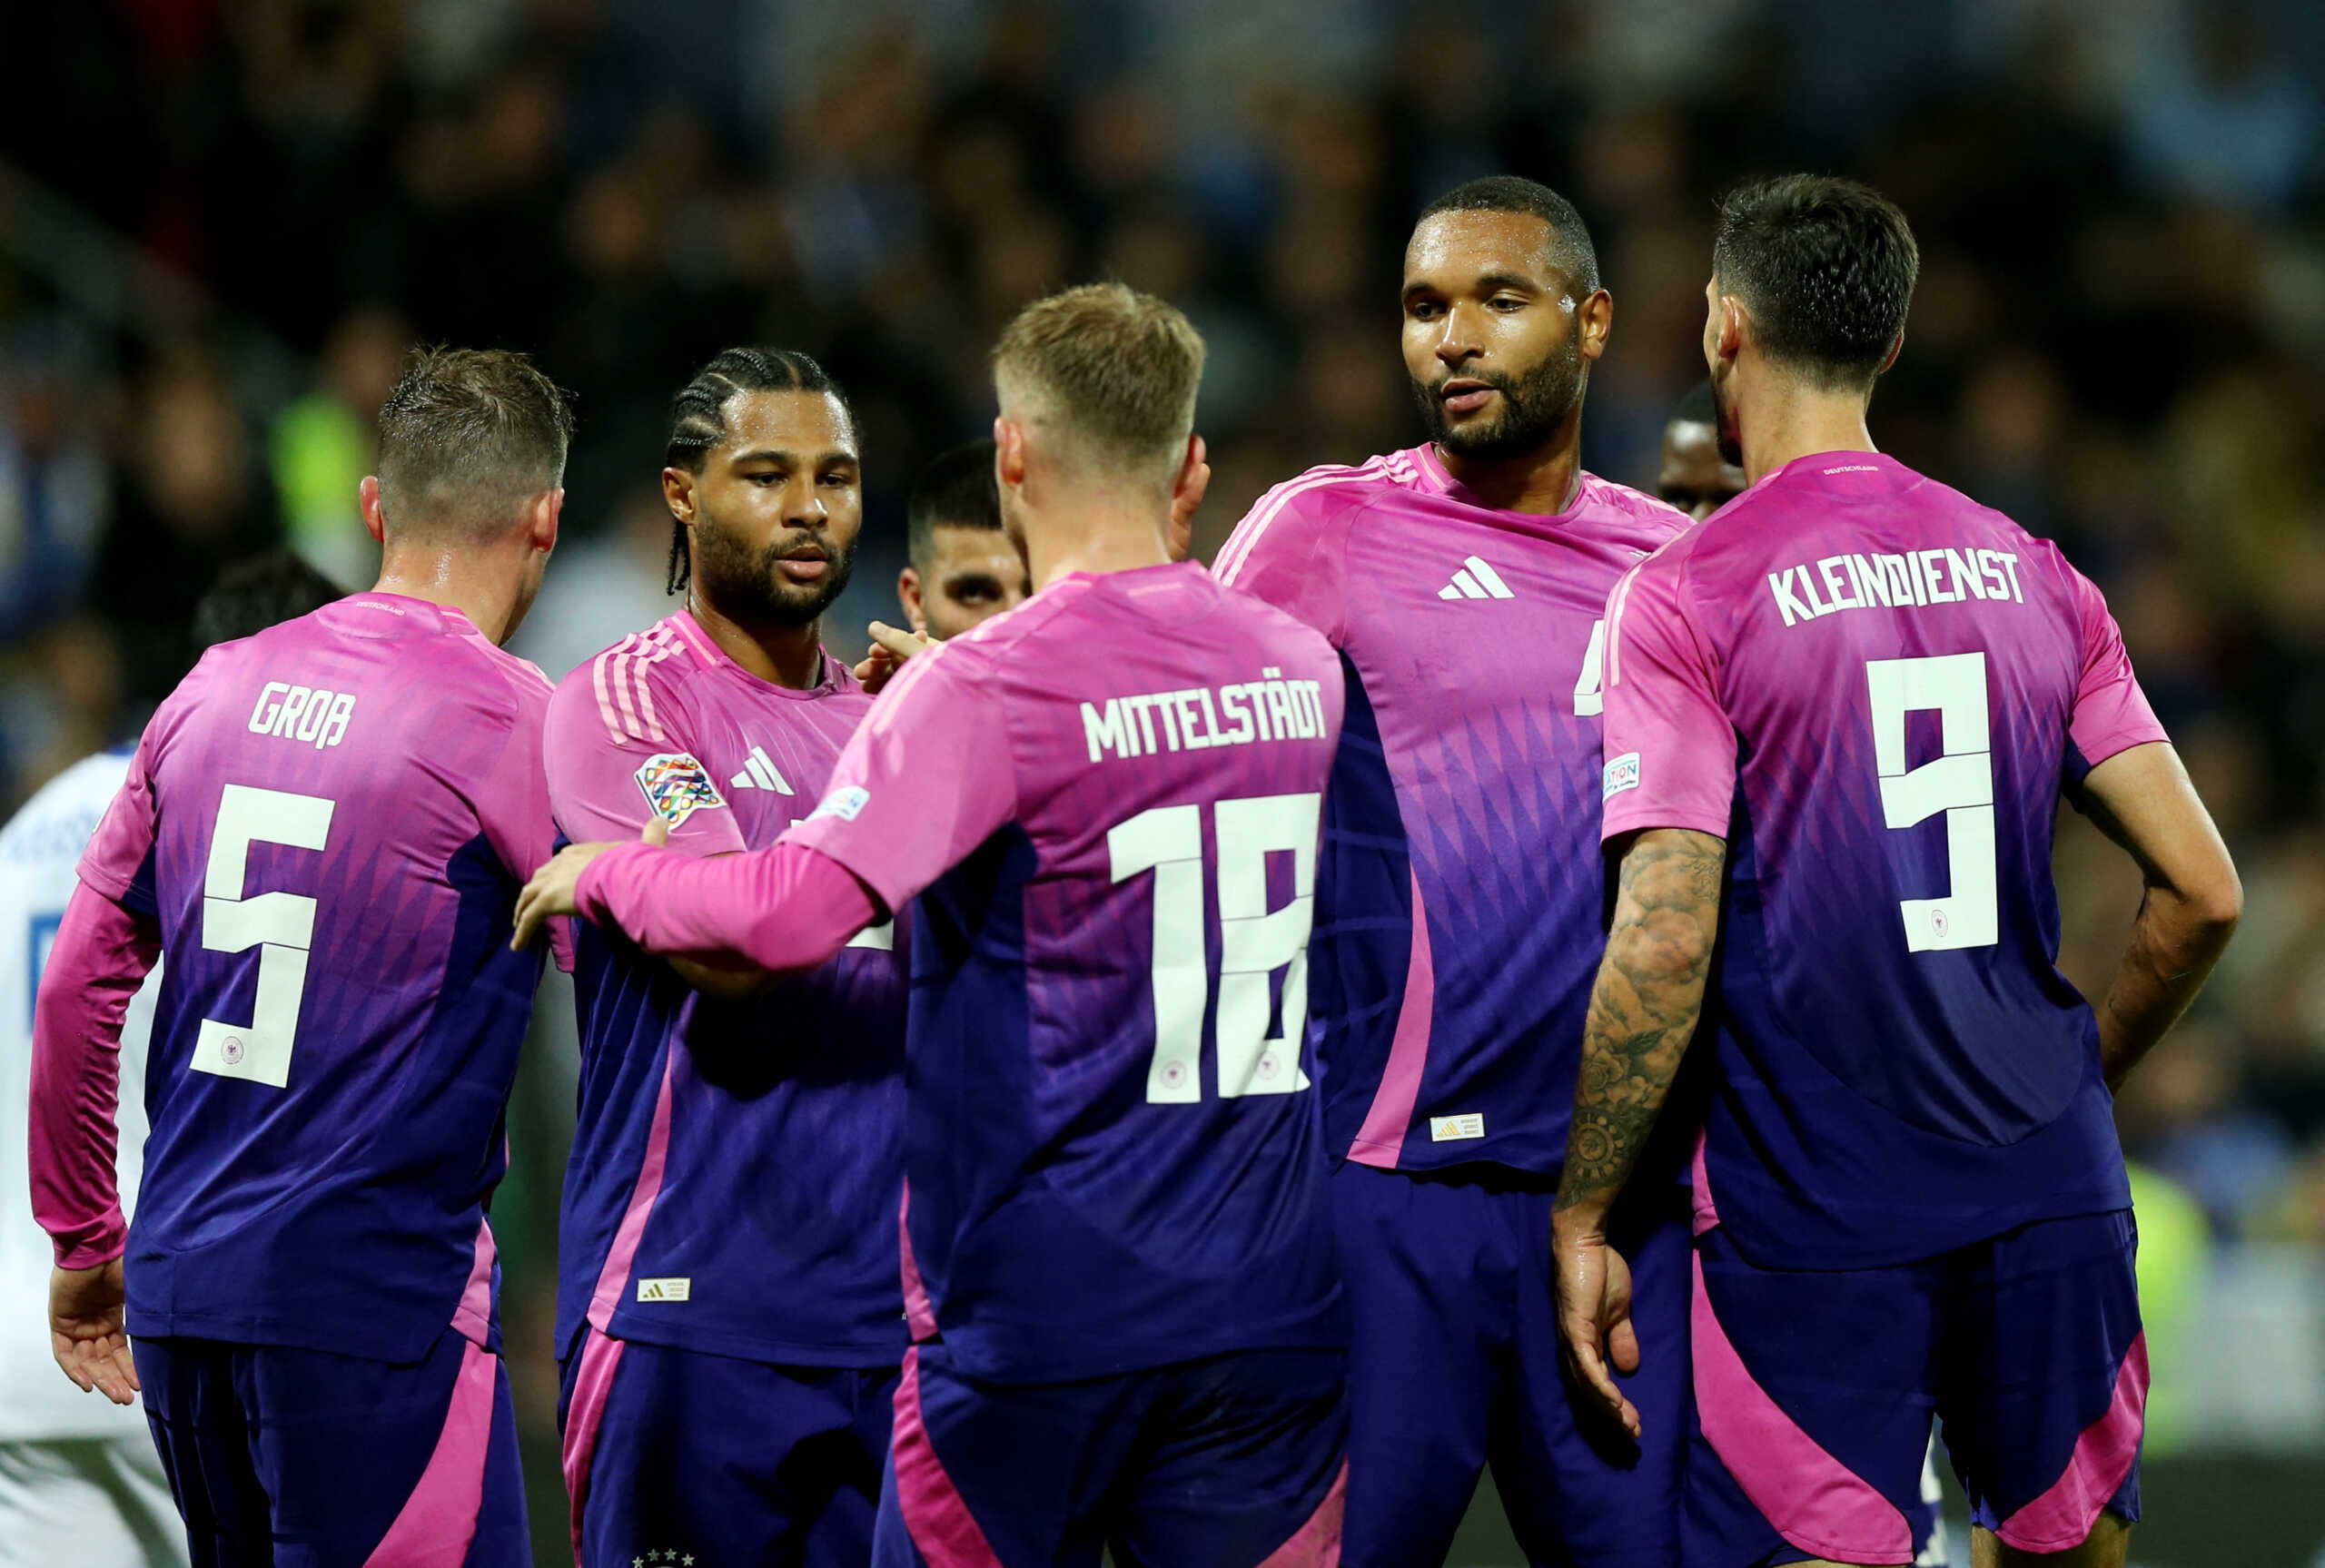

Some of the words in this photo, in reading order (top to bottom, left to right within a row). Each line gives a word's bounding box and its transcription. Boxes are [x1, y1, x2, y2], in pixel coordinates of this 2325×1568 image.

[1081, 666, 1326, 763] MITTELSTÄDT
[1767, 548, 2024, 626] KLEINDIENST
[189, 784, 336, 1089] 5
[1107, 793, 1321, 1104] 18
[1865, 652, 1998, 952] 9
